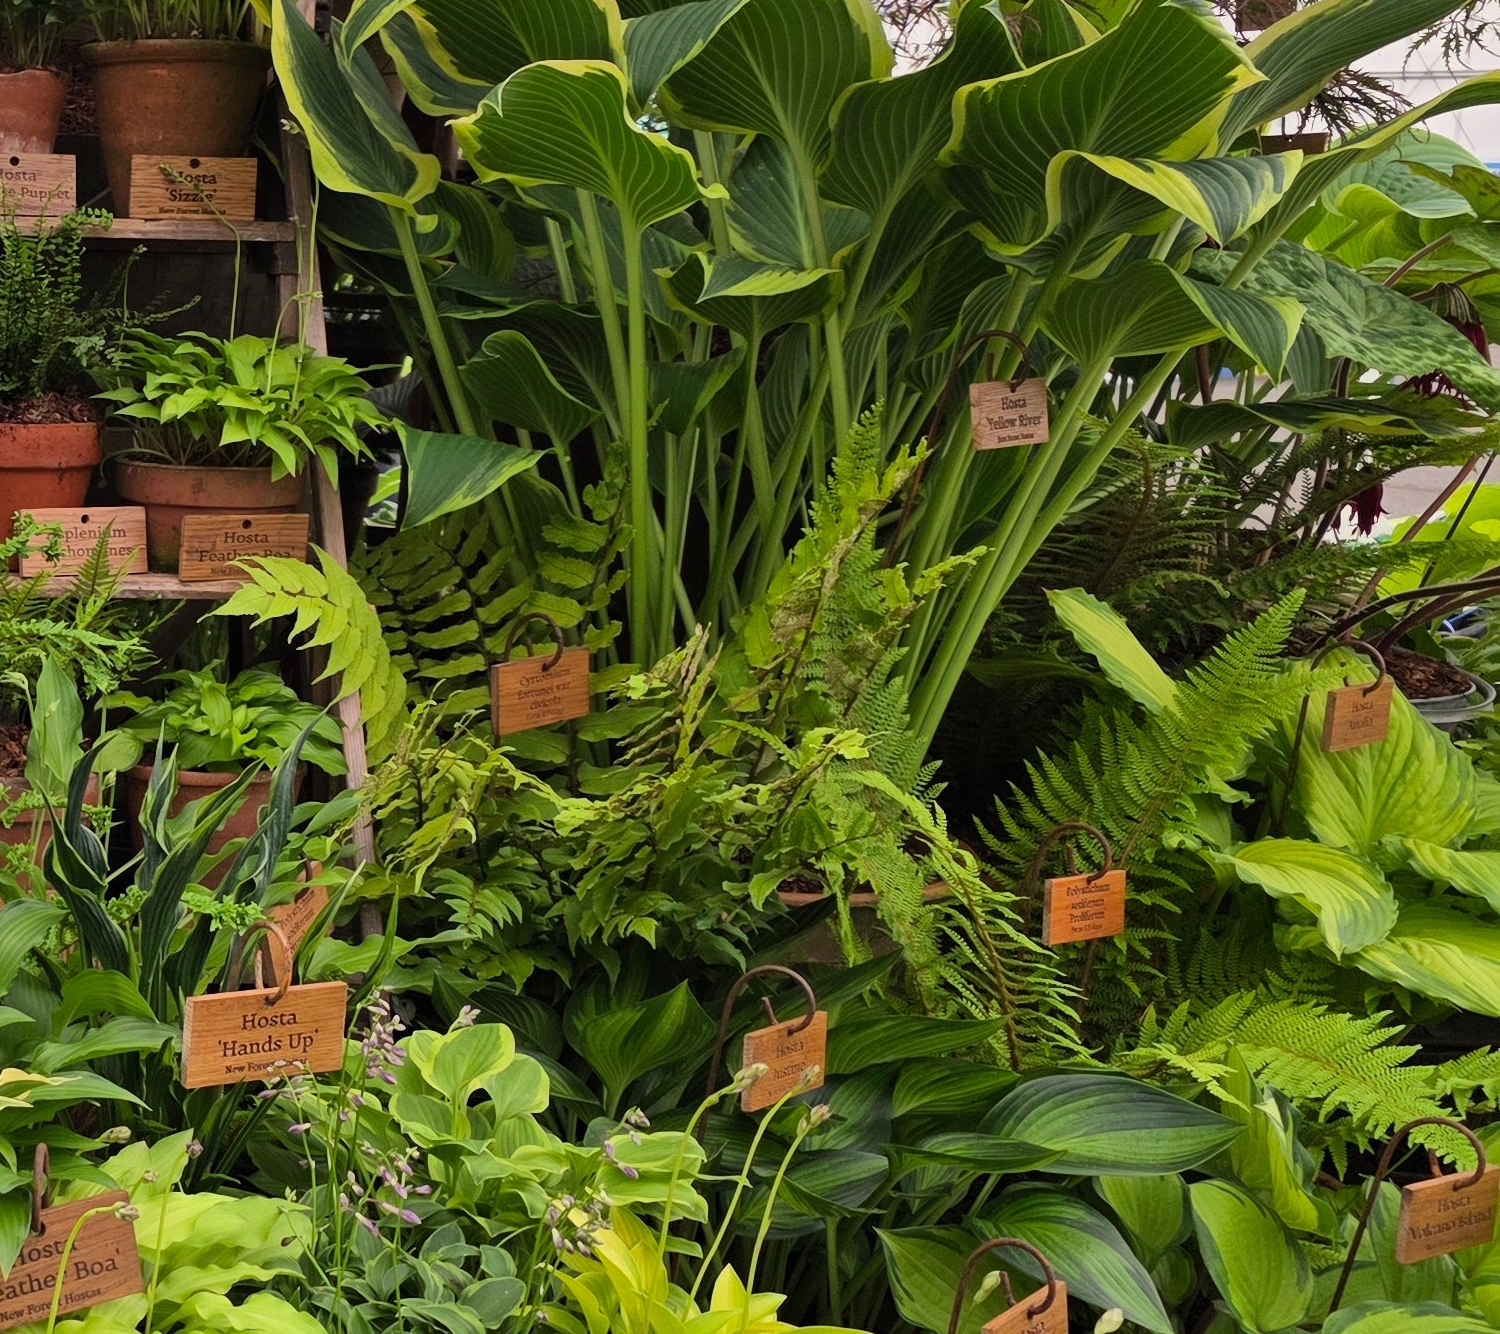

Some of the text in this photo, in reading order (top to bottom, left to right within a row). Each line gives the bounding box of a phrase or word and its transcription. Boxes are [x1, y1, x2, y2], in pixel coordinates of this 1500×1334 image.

[1001, 397, 1027, 410] Hosta
[224, 531, 269, 544] Hosta
[241, 1012, 298, 1030] Hosta
[218, 1029, 319, 1058] 'Hands Up'
[777, 1041, 804, 1058] Hosta
[1438, 1197, 1471, 1213] Hosta
[73, 1248, 121, 1282] Boa'
[0, 1309, 25, 1323] New
[64, 1288, 102, 1305] Hostas
